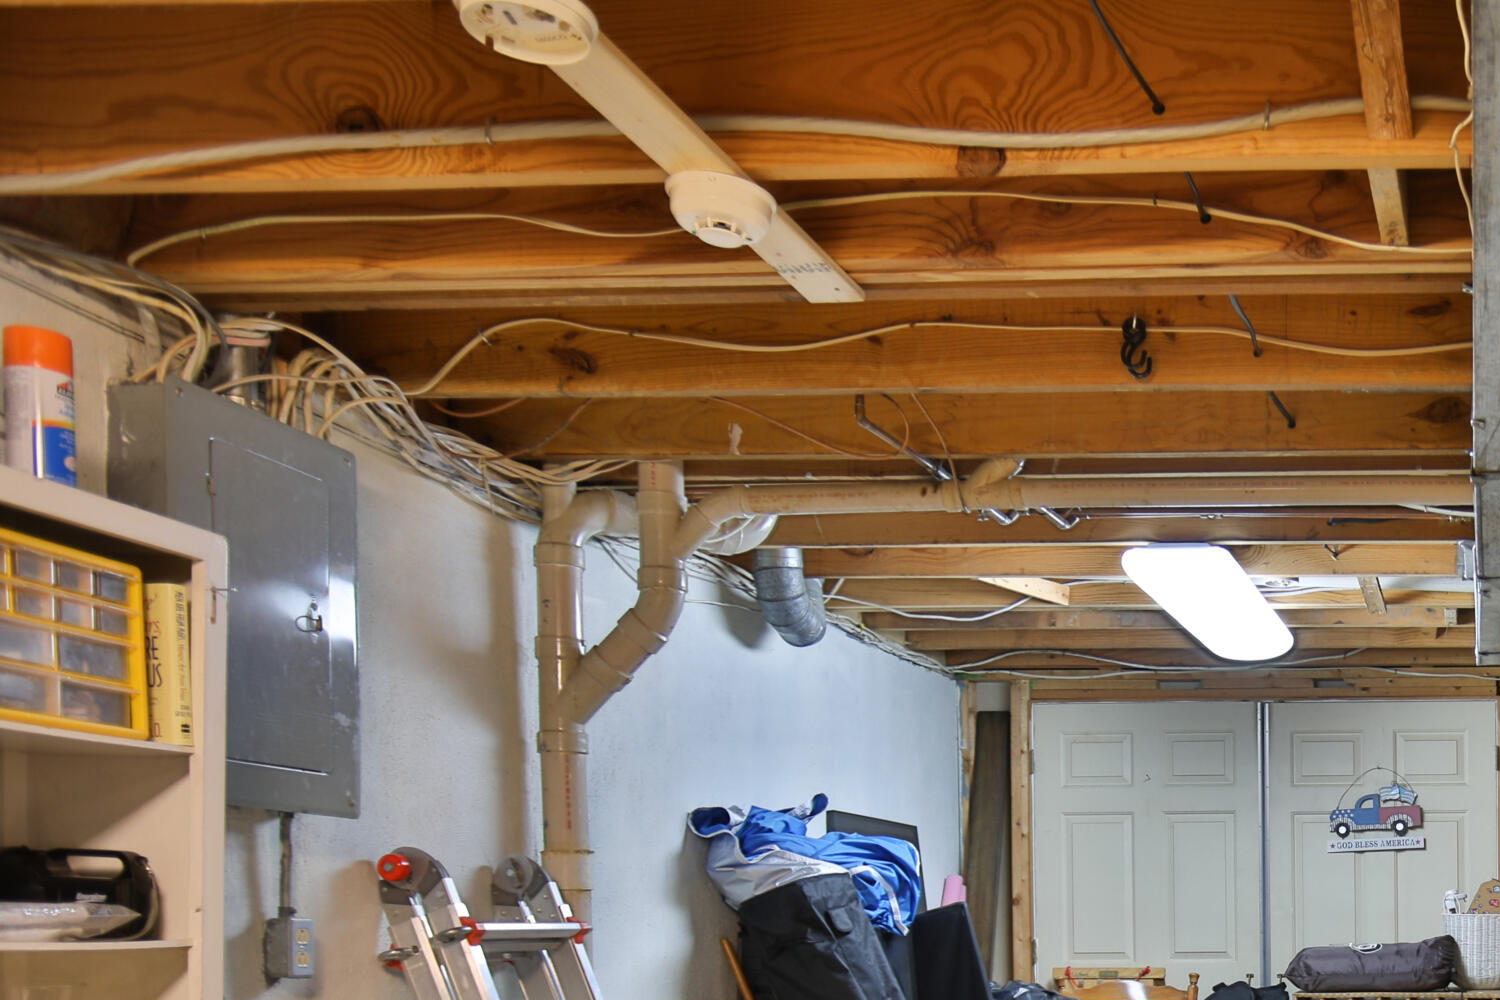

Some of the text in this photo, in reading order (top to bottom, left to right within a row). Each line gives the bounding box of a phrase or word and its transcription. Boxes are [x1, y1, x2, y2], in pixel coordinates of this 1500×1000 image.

[1336, 838, 1416, 849] GOD BLESS AMERICA
